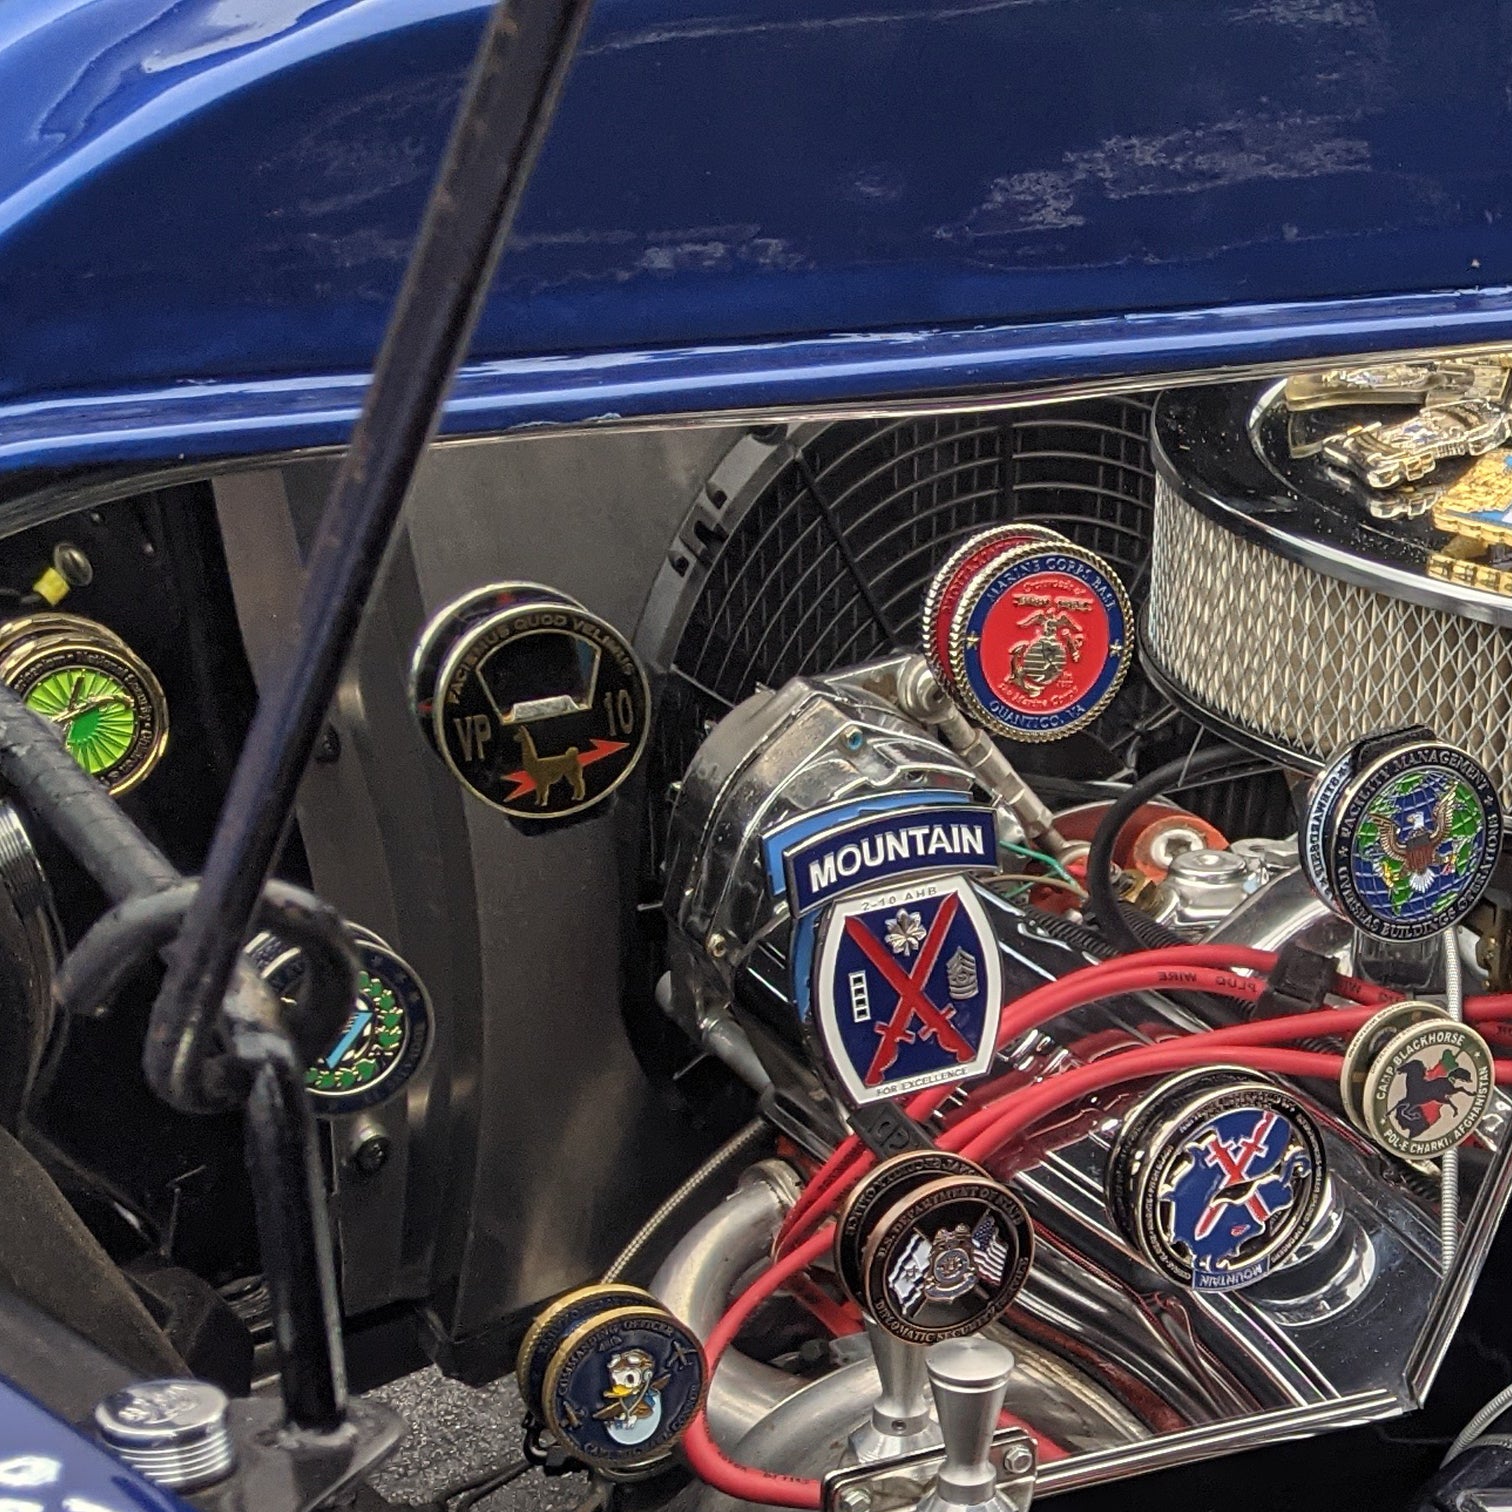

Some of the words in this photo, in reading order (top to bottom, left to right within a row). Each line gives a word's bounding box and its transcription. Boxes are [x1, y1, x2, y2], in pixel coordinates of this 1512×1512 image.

[513, 614, 568, 631] QUOD
[572, 615, 635, 677] VELIMUS
[604, 688, 635, 737] 10
[453, 713, 492, 762] VP
[1341, 766, 1390, 838] FACILITY
[1393, 749, 1490, 792] MANAGEMENT
[809, 823, 985, 893] MOUNTAIN
[1337, 865, 1381, 932] OVERSEAS
[1382, 908, 1457, 938] BUILDINGS
[1456, 813, 1500, 912] OPERATIONS
[861, 894, 897, 911] 2-10
[904, 885, 938, 901] AHB
[876, 1085, 899, 1097] FOR
[900, 1066, 970, 1090] EXCELLENCE
[1376, 1066, 1396, 1101] CAMP
[1392, 1030, 1466, 1067] BLACKHORSE
[1453, 1065, 1490, 1140] AFGHANISTAN
[896, 1186, 980, 1233] DEPARTMENT
[1199, 1264, 1264, 1287] MOUNTAIN
[874, 1299, 935, 1343] DIPLOMATIC
